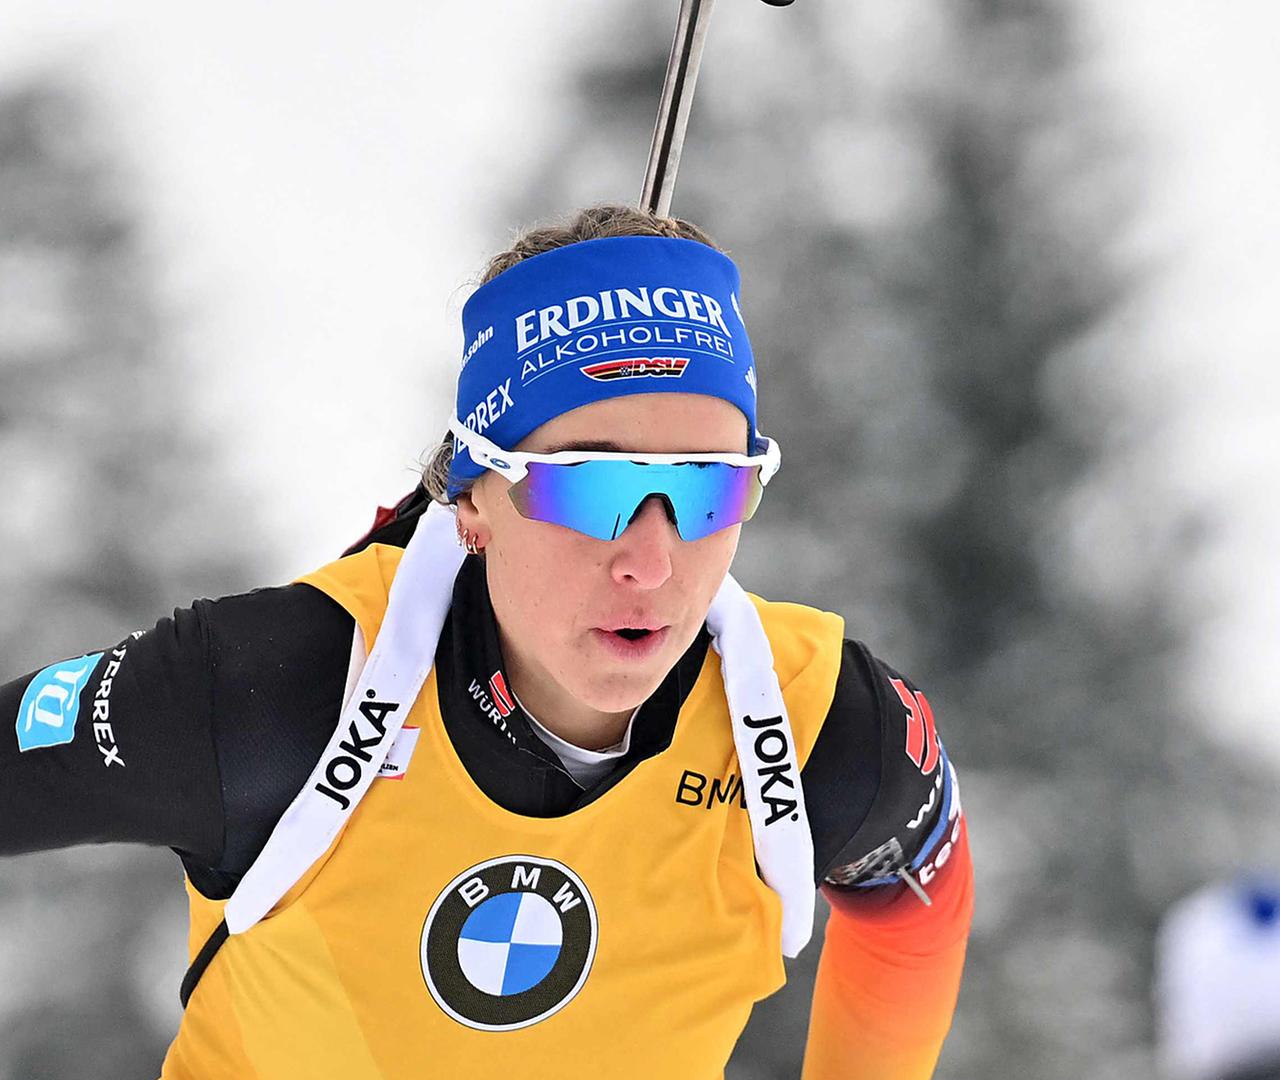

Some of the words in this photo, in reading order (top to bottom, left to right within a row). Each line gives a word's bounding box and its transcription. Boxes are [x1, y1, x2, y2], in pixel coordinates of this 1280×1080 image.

[514, 286, 732, 353] ERDINGER
[521, 326, 734, 380] ALKOHOLFREI
[468, 678, 517, 745] WÜR
[315, 700, 400, 810] JOKA
[743, 715, 799, 827] JOKA
[458, 865, 582, 914] BMW
